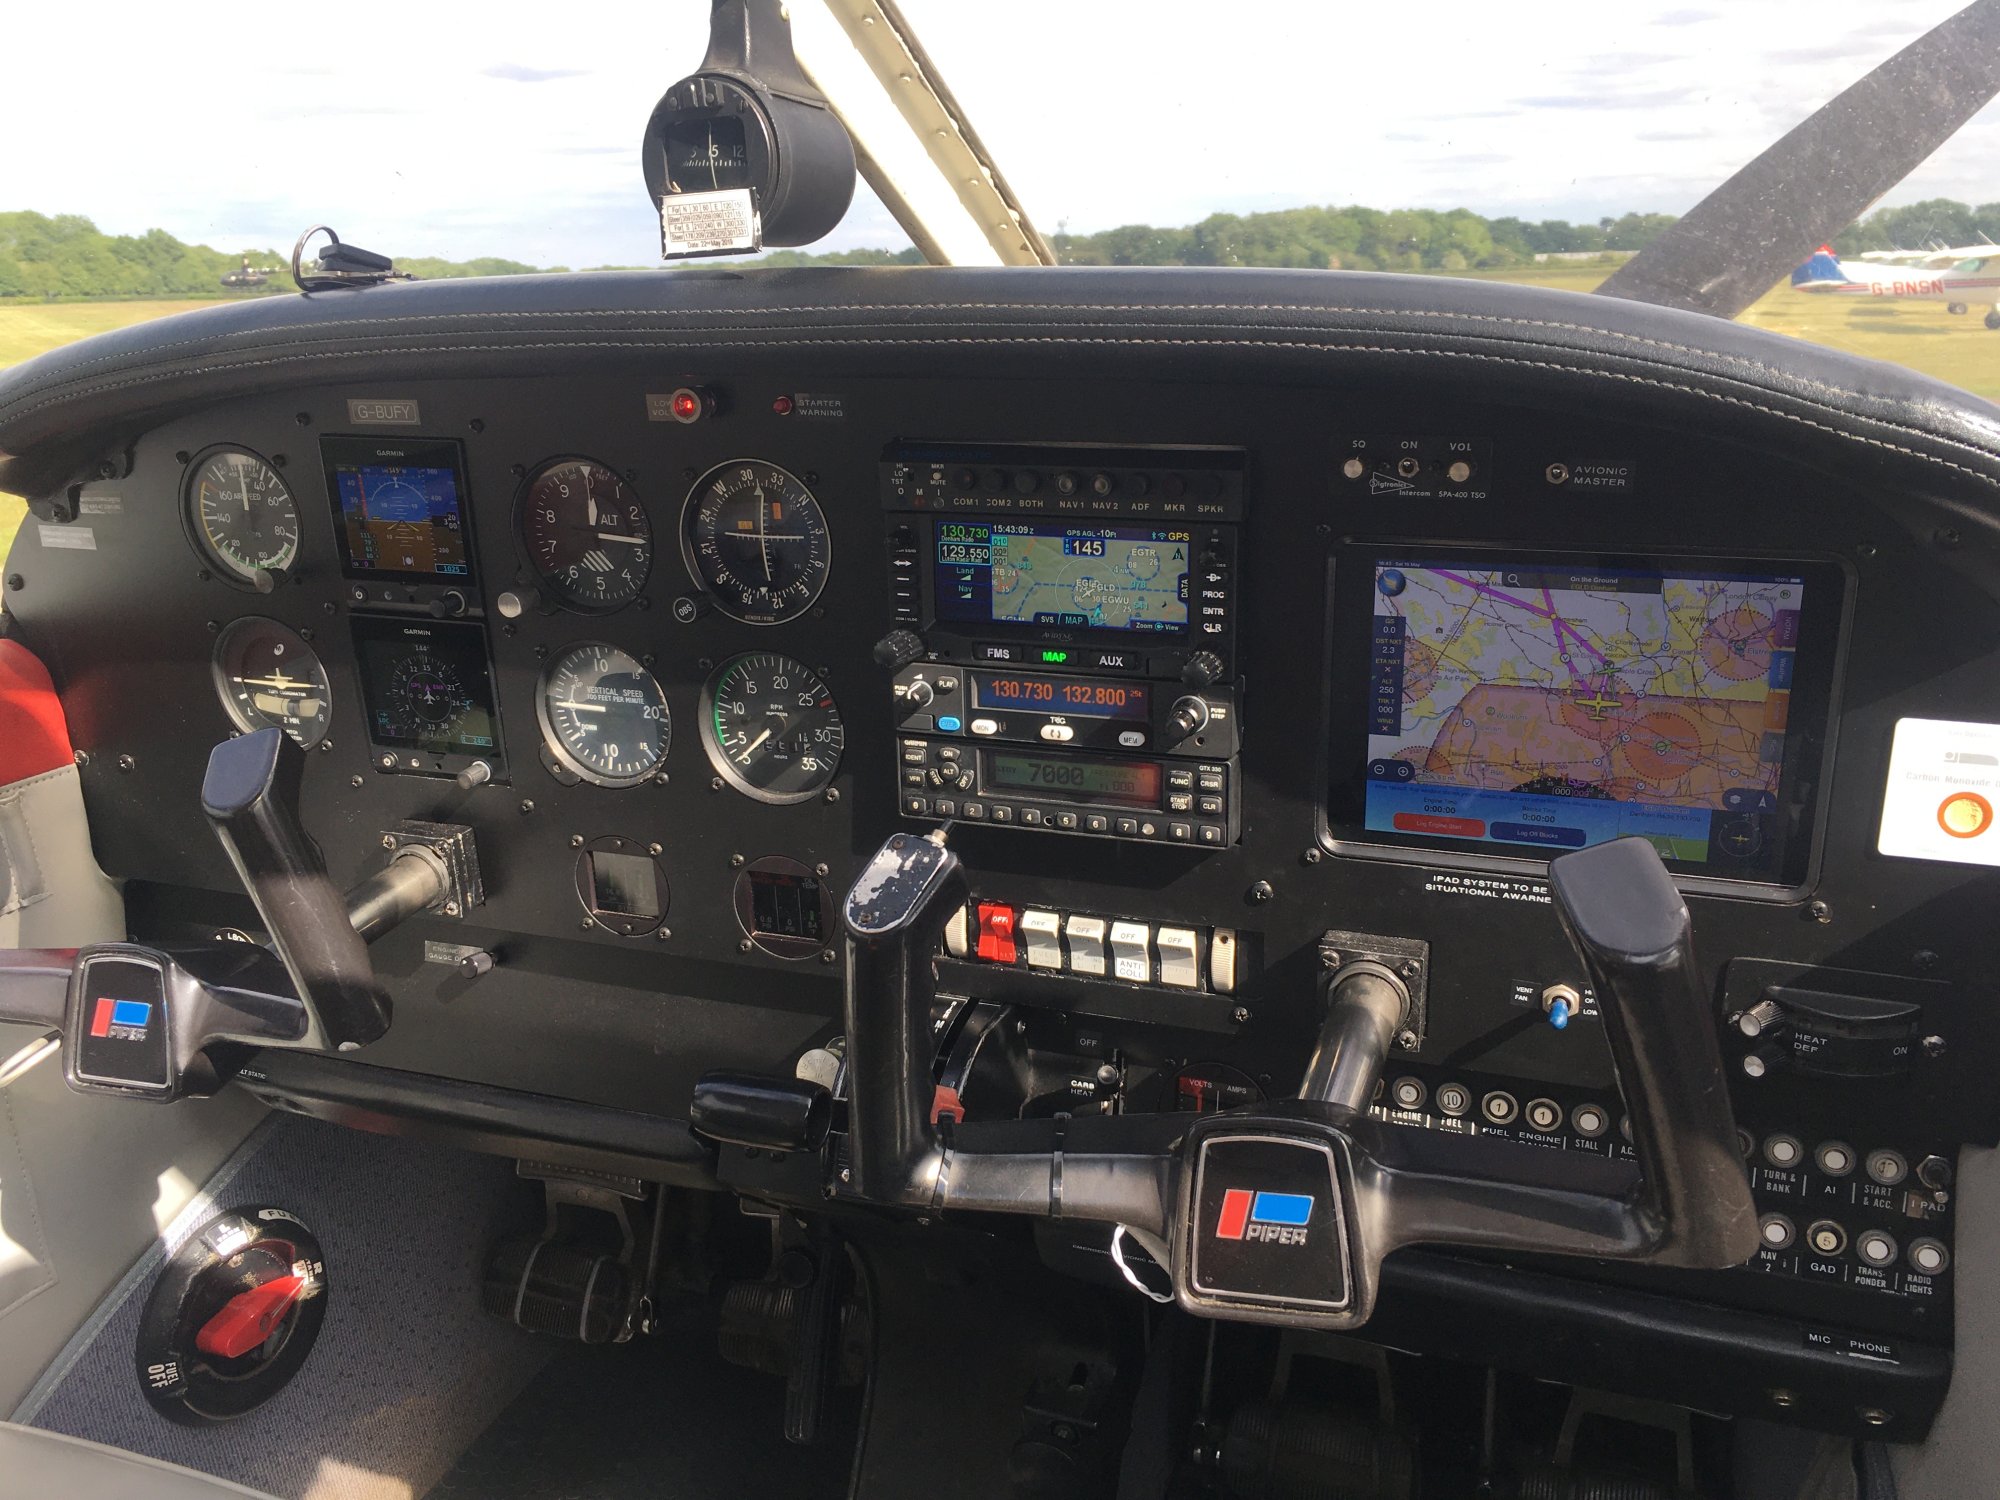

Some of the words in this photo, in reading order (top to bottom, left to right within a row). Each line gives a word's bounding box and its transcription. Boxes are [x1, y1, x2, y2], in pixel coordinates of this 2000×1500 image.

[733, 145, 744, 158] 12
[1871, 280, 1945, 296] G-BNSN
[357, 405, 411, 420] G-BUFY
[800, 409, 844, 417] WARNING
[1352, 440, 1366, 448] SQ
[1401, 441, 1418, 449] ON
[1450, 442, 1472, 452] VOL
[739, 468, 754, 481] 30
[1575, 466, 1628, 476] AVIONIC
[771, 472, 785, 487] 33
[1574, 477, 1626, 486] MASTER
[268, 496, 279, 506] 60
[799, 494, 810, 506] N
[954, 498, 979, 506] COM1
[987, 499, 1012, 507] COM2
[1019, 500, 1044, 508] BOTH
[1131, 503, 1150, 511] ADF
[1164, 504, 1185, 512] MKR
[1197, 505, 1224, 513] SPKR
[630, 506, 640, 520] 2
[601, 514, 618, 526] ALT
[274, 526, 285, 536] 80
[941, 525, 989, 538] 130.730
[993, 525, 1028, 534] 15:43:09
[1168, 532, 1190, 541] GPS
[941, 546, 989, 559] 129.550
[1073, 540, 1103, 555] 145
[634, 548, 644, 562] 3
[956, 567, 974, 575] Land
[1181, 579, 1189, 598] DATA
[1203, 591, 1225, 599] PROC
[1102, 597, 1129, 605] EGWU
[678, 603, 693, 617] OBS
[1203, 607, 1224, 616] ENTR
[1065, 617, 1083, 625] MAP
[1203, 623, 1222, 632] CLR
[987, 648, 1010, 659] FMS
[1042, 651, 1067, 663] MAP
[593, 658, 609, 673] 10
[1099, 656, 1124, 667] AUX
[746, 681, 758, 695] 15
[773, 676, 789, 690] 20
[938, 680, 954, 688] PLAY
[587, 686, 618, 696] VERTICAL
[623, 689, 644, 698] SPEED
[991, 680, 1053, 700] 130.730
[1379, 686, 1395, 694] 250
[625, 697, 645, 705] MINUTE
[798, 693, 814, 707] 25
[1062, 685, 1127, 707] 132.800
[643, 705, 660, 720] 20
[815, 729, 831, 743] 30
[801, 757, 817, 771] 35
[1027, 762, 1084, 785] 7000
[1906, 771, 1940, 783] Carbon
[1945, 775, 1991, 787] Monoxide
[1170, 778, 1189, 786] FUNC
[1200, 780, 1219, 788] CRSR
[1170, 796, 1188, 804] START
[1202, 802, 1216, 810] CLR
[1424, 805, 1456, 814] 0:00:00
[1522, 814, 1555, 823] 0:00:00
[1517, 829, 1528, 839] Log
[1433, 875, 1460, 884] IPAD
[1463, 878, 1509, 890] SYSTEM
[1532, 886, 1548, 894] BE
[1425, 883, 1499, 898] SITUATIONAL
[1120, 961, 1142, 969] ANTI
[1120, 968, 1144, 978] COLL
[1516, 986, 1534, 994] VENT
[1079, 1038, 1098, 1047] OFF
[1795, 1032, 1828, 1046] HEAT
[1793, 1042, 1819, 1053] DEF
[1893, 1047, 1908, 1056] ON
[1071, 1079, 1096, 1090] CARB
[1189, 1078, 1213, 1089] VOLTS
[1226, 1085, 1247, 1094] AMPS
[1071, 1089, 1094, 1097] HEAT
[1483, 1126, 1510, 1138] FUEL
[1519, 1131, 1562, 1145] ENGINE
[1575, 1138, 1599, 1151] STALL
[1763, 1169, 1787, 1181] TURN
[1790, 1174, 1796, 1183] &
[1766, 1181, 1791, 1194] BANK
[1824, 1185, 1836, 1195] AI
[1864, 1185, 1893, 1197] START
[1863, 1197, 1870, 1207] &
[1920, 1201, 1946, 1212] PAD
[1246, 1224, 1308, 1246] PIPER
[1760, 1251, 1777, 1261] NAV
[1765, 1263, 1772, 1273] 2
[1810, 1262, 1836, 1274] GAD
[1858, 1266, 1886, 1278] TRANS-
[1855, 1275, 1887, 1288] PONDER
[1907, 1274, 1932, 1285] RADIO
[1904, 1283, 1933, 1295] LIGHTS
[1809, 1333, 1832, 1344] MIC
[1850, 1340, 1891, 1354] PHONE
[147, 1364, 169, 1388] OFF
[165, 1362, 180, 1385] FUEL
